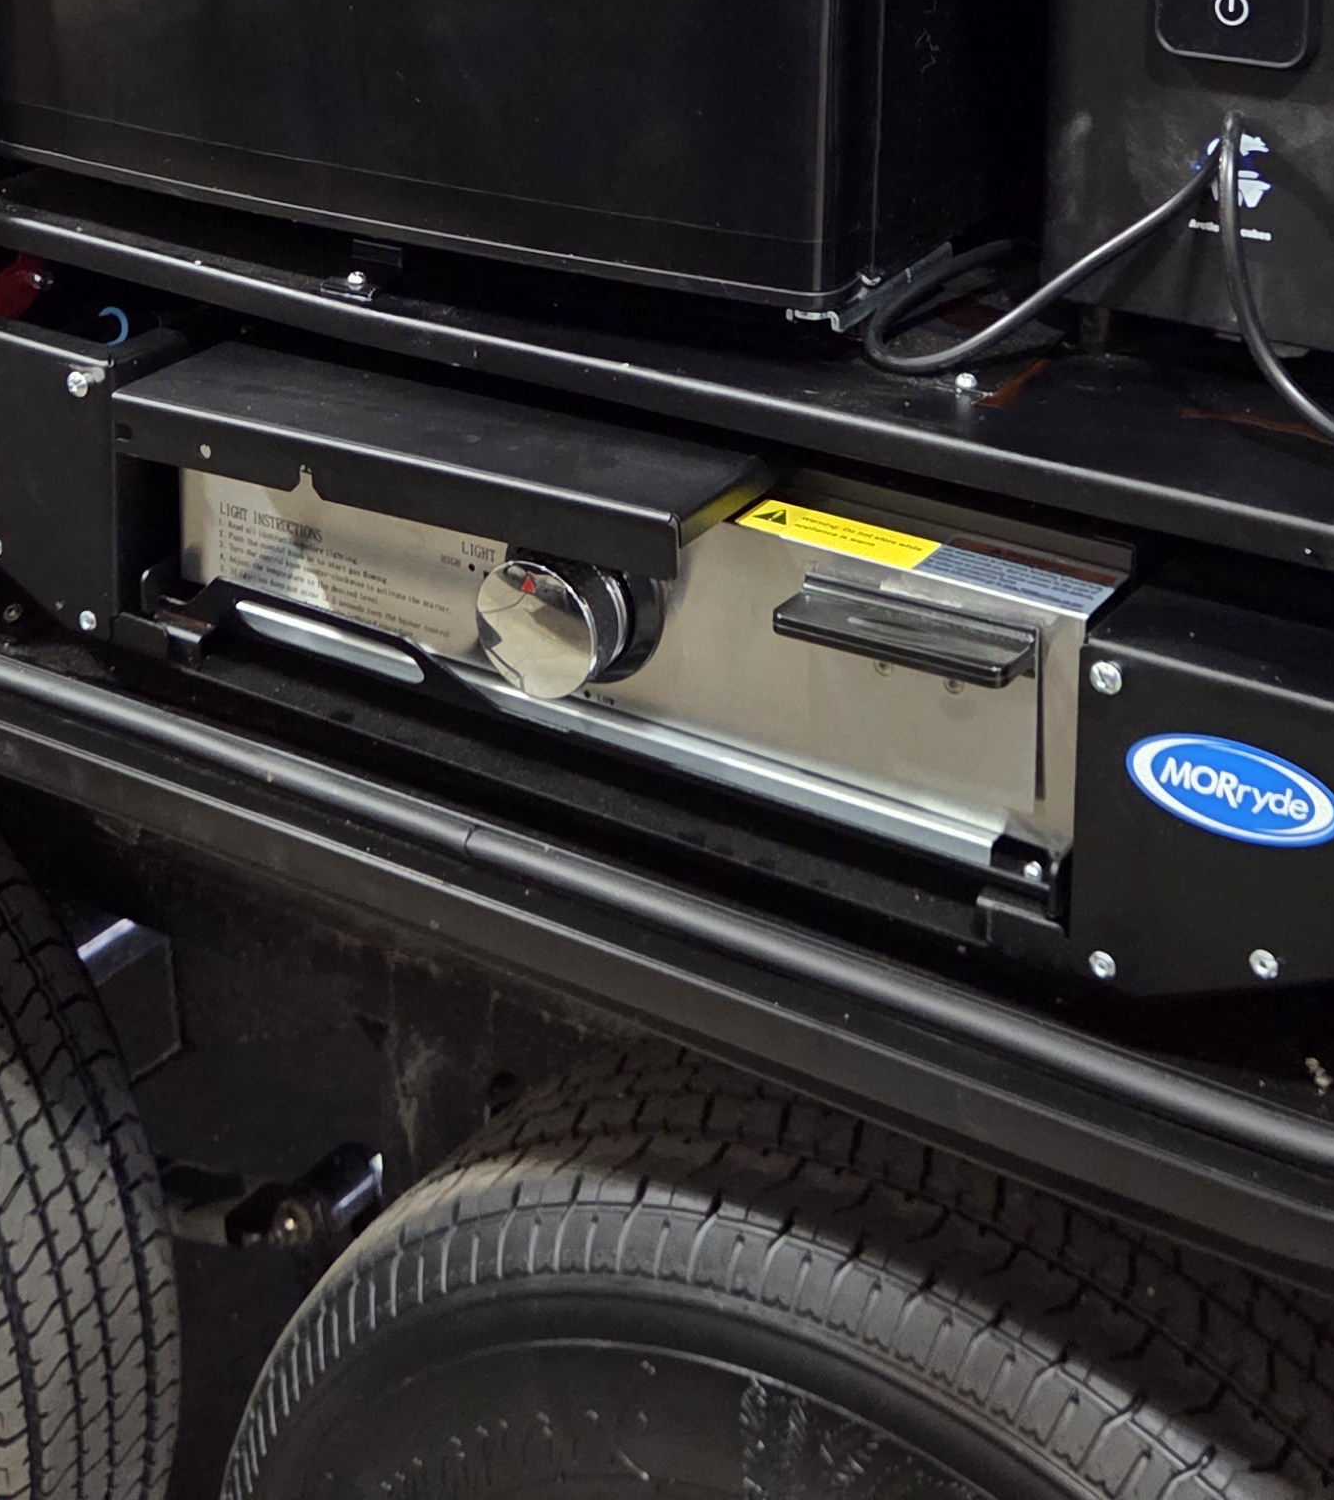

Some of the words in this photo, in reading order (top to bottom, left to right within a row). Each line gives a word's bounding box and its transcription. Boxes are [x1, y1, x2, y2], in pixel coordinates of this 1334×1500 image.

[220, 502, 248, 521] LIGHT
[254, 511, 322, 542] INSTRUCTIONS
[229, 532, 245, 543] Push
[462, 541, 496, 563] LIGHT
[1159, 756, 1309, 821] MORryde
